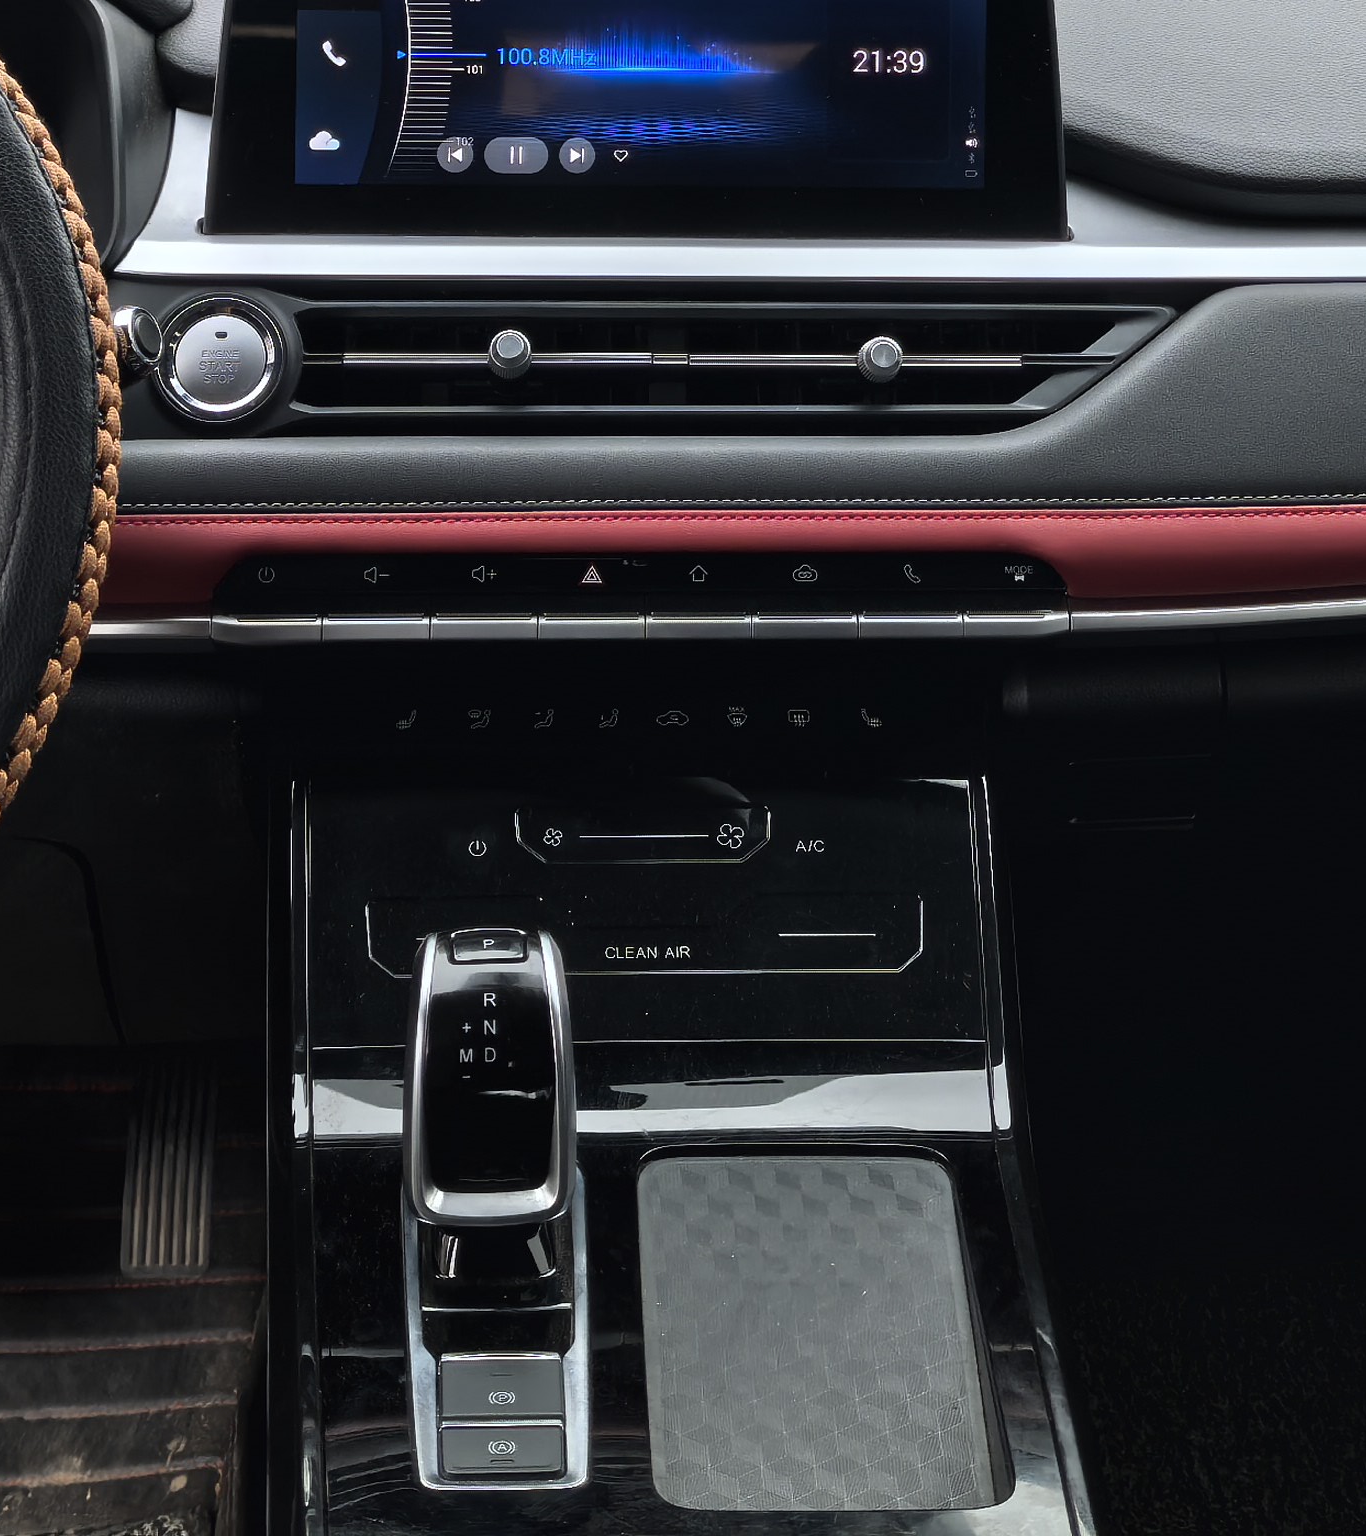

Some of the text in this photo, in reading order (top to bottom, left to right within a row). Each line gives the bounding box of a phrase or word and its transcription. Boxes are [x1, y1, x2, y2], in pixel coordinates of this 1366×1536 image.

[497, 48, 597, 66] 100.8MHz
[852, 50, 925, 74] 21:39
[466, 66, 483, 75] 101
[456, 137, 474, 146] 102
[201, 349, 240, 359] ENGINE
[199, 360, 242, 373] START
[203, 374, 235, 385] STOP
[1004, 565, 1034, 575] MODE
[795, 839, 825, 853] A/C
[483, 938, 495, 949] P
[604, 945, 691, 959] CLEAN AIR
[483, 992, 497, 1007] R
[483, 1019, 496, 1035] N
[459, 1047, 497, 1063] M D
